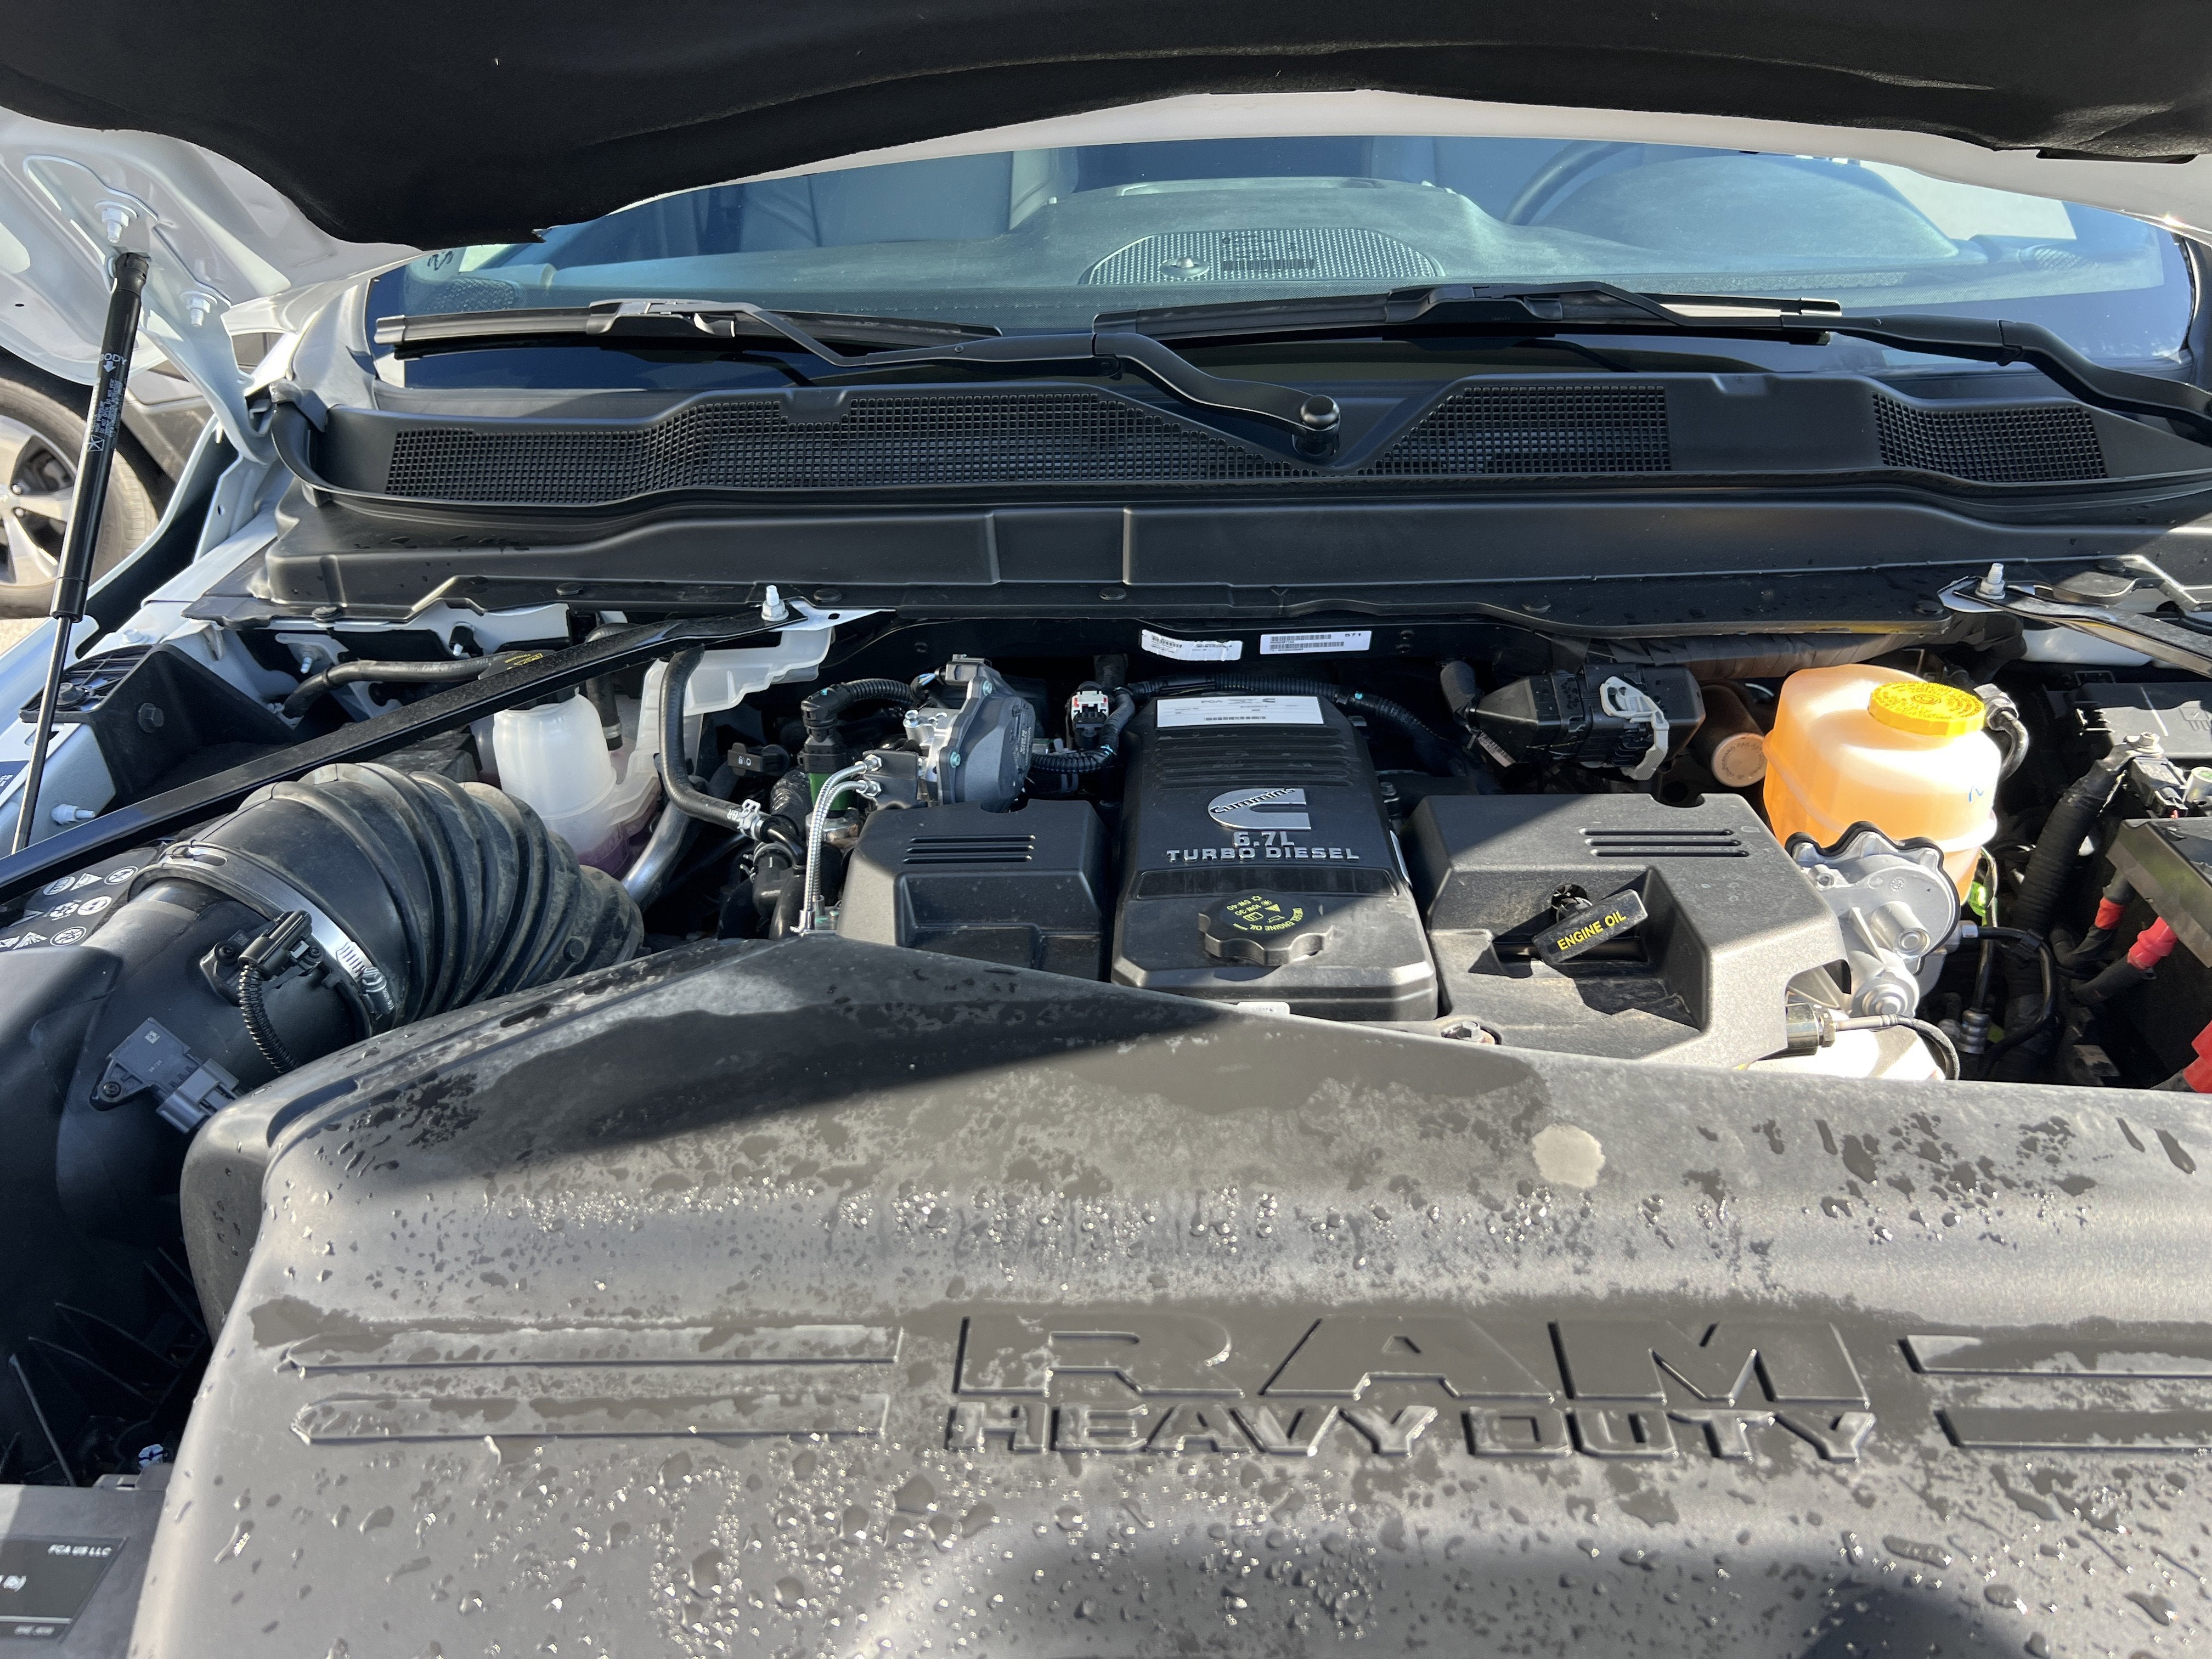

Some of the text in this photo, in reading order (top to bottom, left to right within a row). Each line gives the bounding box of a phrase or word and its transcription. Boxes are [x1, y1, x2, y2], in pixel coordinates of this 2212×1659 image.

[1210, 787, 1296, 814] Cummins
[1233, 831, 1295, 848] 6.7L
[1166, 847, 1360, 863] TURBO DIESEL
[1264, 920, 1295, 931] ENGINE
[1556, 910, 1627, 951] ENGINE OIL
[952, 1316, 1870, 1408] RAM
[944, 1402, 1876, 1463] HEAVY DUTY
